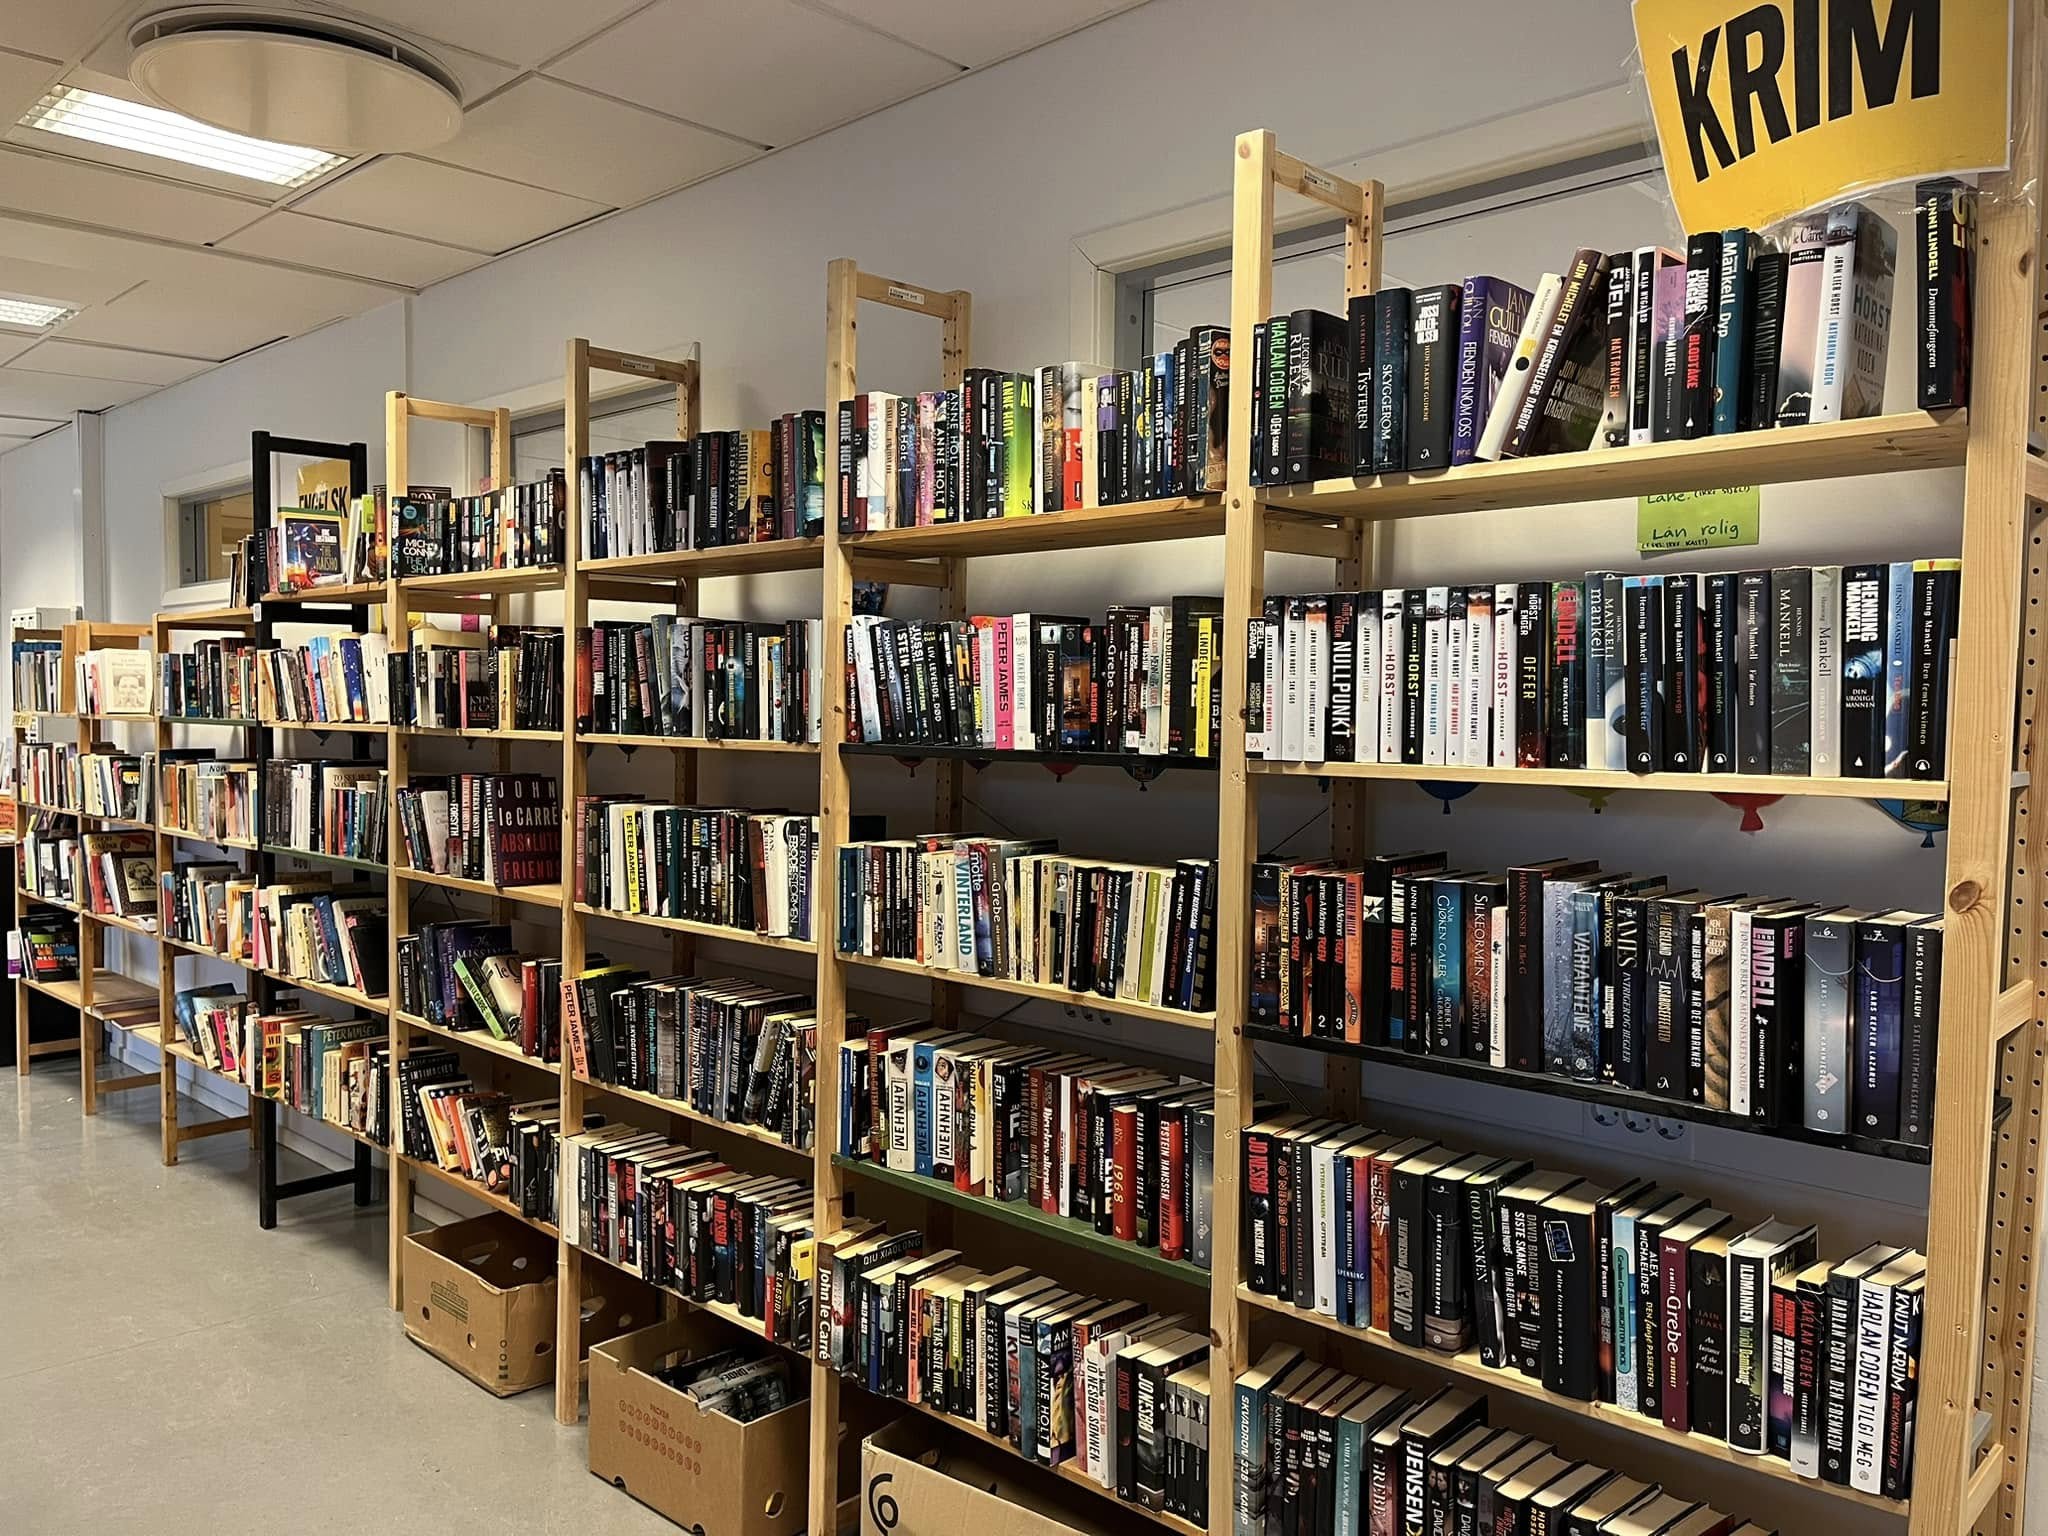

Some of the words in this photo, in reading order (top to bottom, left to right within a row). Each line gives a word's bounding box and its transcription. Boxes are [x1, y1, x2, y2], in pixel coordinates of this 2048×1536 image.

[1672, 0, 1940, 182] KRIM
[1927, 198, 1937, 229] UNNI
[1574, 261, 1588, 279] JON
[1719, 242, 1737, 305] Mankell
[1928, 232, 1939, 280] LINDELL
[1472, 295, 1484, 319] JAN
[1556, 281, 1581, 323] MICHELET
[1607, 268, 1624, 324] FJELL
[1686, 269, 1699, 314] ENGER
[1696, 268, 1710, 312] THOMAS
[1552, 323, 1565, 336] EN
[1716, 312, 1732, 337] Dyp
[1926, 287, 1938, 368] Drømmefangeren
[1270, 322, 1288, 367] HARLAN
[1289, 334, 1302, 385] RILEY
[1300, 337, 1311, 381] LUCINDA
[1461, 341, 1477, 384] FIENDEN
[1664, 340, 1677, 376] MANKELL
[1686, 334, 1701, 389] BLODTÅKE
[1528, 338, 1559, 395] KRIGSSEILERS
[1610, 338, 1623, 397] NATTRAVNEN
[1002, 381, 1013, 410] ANNE
[1268, 371, 1285, 408] COBEN
[1357, 368, 1372, 429] TYSTEREN
[1381, 364, 1393, 440] SKYGGEROM
[1460, 387, 1474, 415] INOM
[840, 411, 851, 441] ANNE
[900, 401, 908, 430] Anne
[950, 392, 958, 429] ANNE
[1003, 411, 1014, 437] HOLT
[1155, 404, 1164, 439] HORST
[1270, 418, 1281, 434] DEN
[1458, 416, 1471, 437] OSS
[1516, 397, 1537, 431] DAGBOK
[738, 444, 749, 486] GIOLITO
[840, 445, 851, 473] HOLT
[900, 435, 908, 460] Holt
[935, 428, 944, 464] ANNE
[950, 436, 958, 467] HOLT
[936, 470, 944, 504] HOLT
[1701, 519, 1739, 539] rolig
[1674, 594, 1684, 627] Henning
[1714, 593, 1724, 627] Henning
[1846, 582, 1862, 642] MANKELL
[1861, 580, 1878, 641] HENNING
[1922, 579, 1935, 616] Henning
[1556, 588, 1576, 665] LINDELL
[1590, 589, 1605, 658] mankell
[1604, 598, 1615, 661] MANKELL
[1779, 589, 1791, 656] MANKELL
[1923, 620, 1934, 655] Mankell
[998, 622, 1007, 664] PETER
[1047, 649, 1055, 672] JOHN
[1198, 632, 1208, 671] LINDELL
[1675, 631, 1684, 662] Mankell
[1715, 630, 1724, 662] Mankell
[1818, 627, 1831, 678] Mankell
[1107, 644, 1116, 688] Grebe
[1385, 654, 1395, 696] HORST
[1523, 656, 1537, 699] OFFER
[1921, 662, 1931, 680] Den
[999, 668, 1008, 712] JAMES
[1331, 641, 1352, 738] NULLPUNKT
[1674, 671, 1684, 713] Brannvegg
[1714, 671, 1724, 713] Pyramiden
[1921, 683, 1930, 707] femte
[1919, 711, 1928, 744] kvinnen
[498, 781, 555, 798] JOHN
[499, 807, 513, 826] le
[516, 802, 558, 826] CARRÉ
[626, 815, 635, 848] PETER
[799, 825, 807, 848] KEN
[628, 850, 636, 884] JAMES
[956, 861, 972, 955] VINTERLAND
[991, 882, 1002, 922] Grebe
[1437, 895, 1450, 940] GJØKEN
[1604, 891, 1613, 916] Stuart
[1659, 912, 1671, 925] TOM
[1473, 894, 1488, 976] SILKEORMEN
[1604, 919, 1613, 947] Woods
[1659, 927, 1672, 955] EGELAND
[1438, 943, 1447, 977] GALER
[1752, 928, 1775, 1008] LINDELL
[1573, 931, 1591, 1032] VARIANTENE
[563, 985, 576, 1017] PETER
[570, 1020, 582, 1053] JAMES
[1658, 981, 1671, 1042] LASARUSEFFEKTEN
[1868, 1051, 1876, 1088] LAZARUS
[1078, 1108, 1088, 1148] ROBERT
[1160, 1120, 1172, 1158] EYSTEIN
[1248, 1137, 1267, 1153] JO
[1078, 1149, 1088, 1187] WILSON
[1113, 1164, 1124, 1203] 1968
[1160, 1159, 1171, 1200] HANSSEN
[1249, 1156, 1269, 1194] NESBØ
[1254, 1219, 1264, 1266] PANSERHJERTE
[1514, 1211, 1525, 1237] SISTE
[1526, 1214, 1538, 1242] DAVID
[1516, 1240, 1527, 1276] SKANSE
[1527, 1245, 1539, 1291] BALDACCI
[1600, 1237, 1608, 1263] Karin
[1639, 1230, 1649, 1295] MICHAELIDES
[1649, 1251, 1659, 1277] ALEX
[774, 1271, 784, 1315] SLAGSIDE
[818, 1268, 832, 1304] John
[1504, 1267, 1515, 1317] FORRÆDEREN
[1601, 1265, 1609, 1298] Fossum
[1740, 1264, 1754, 1323] ILDMANNEN
[820, 1306, 832, 1320] le
[1666, 1295, 1682, 1353] Grebe
[1831, 1298, 1848, 1336] HARLAN
[1860, 1289, 1884, 1350] HARLAN
[1894, 1292, 1910, 1334] KNUT
[818, 1322, 832, 1360] Carré
[1739, 1326, 1753, 1348] Torkil
[1772, 1334, 1782, 1374] MANNEN
[1830, 1340, 1846, 1372] COBEN
[1039, 1359, 1051, 1401] ANNE
[1086, 1359, 1099, 1375] JO
[1736, 1349, 1753, 1385] Damhaug
[1858, 1351, 1880, 1400] COBEN
[1890, 1335, 1908, 1392] NÆRUM
[1086, 1377, 1099, 1414] NESBØ
[1830, 1379, 1844, 1399] DEN
[1039, 1404, 1051, 1442] HOLT
[1088, 1416, 1101, 1462] SØNNEN
[1240, 1395, 1249, 1457] SKVADRON
[1274, 1406, 1282, 1436] KARIN
[1827, 1402, 1843, 1453] FREMMEDE
[1240, 1460, 1249, 1481] 338
[1273, 1438, 1281, 1475] FOSSUM
[1856, 1440, 1874, 1468] MEG
[1405, 1446, 1423, 1524] JENSEN
[1240, 1491, 1248, 1525] KAMP
